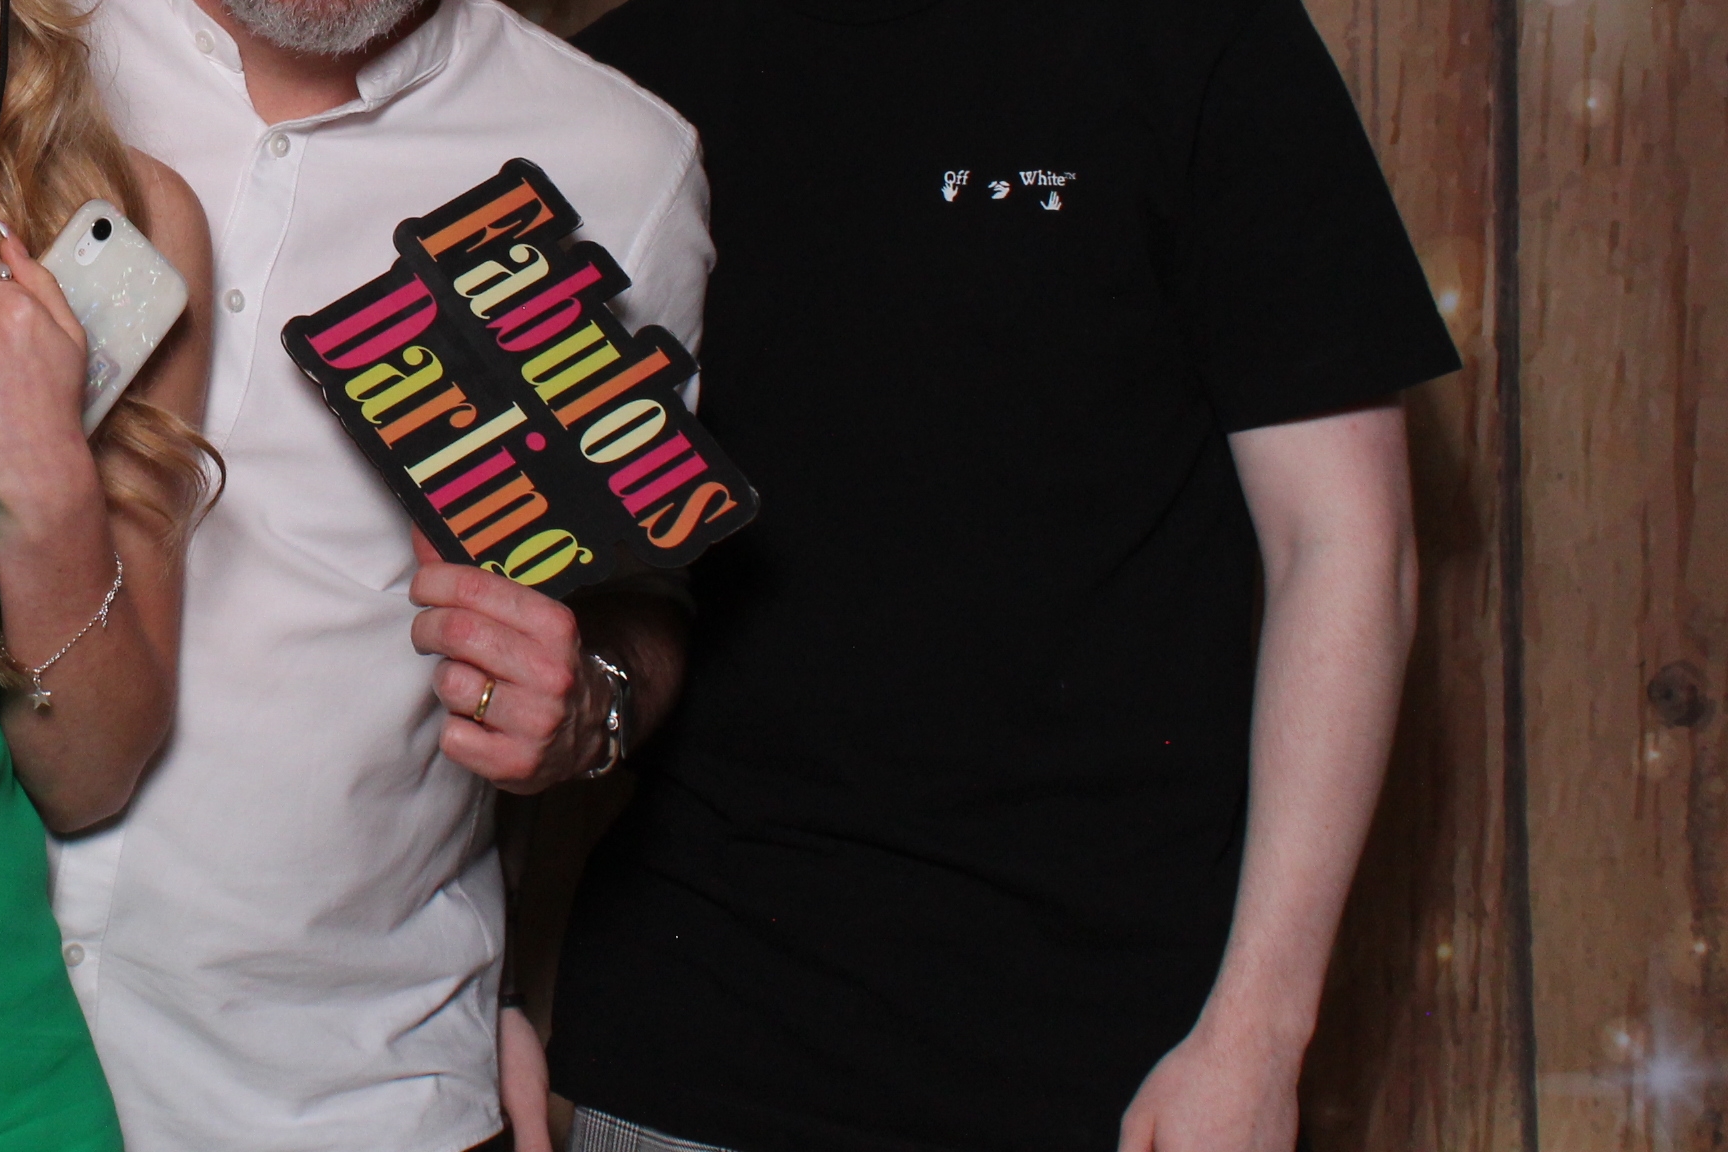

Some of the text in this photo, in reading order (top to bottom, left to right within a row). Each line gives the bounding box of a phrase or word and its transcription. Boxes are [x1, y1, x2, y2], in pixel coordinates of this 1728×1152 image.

[943, 169, 971, 186] Off
[304, 273, 594, 586] Darling
[416, 177, 738, 549] Fabulous
